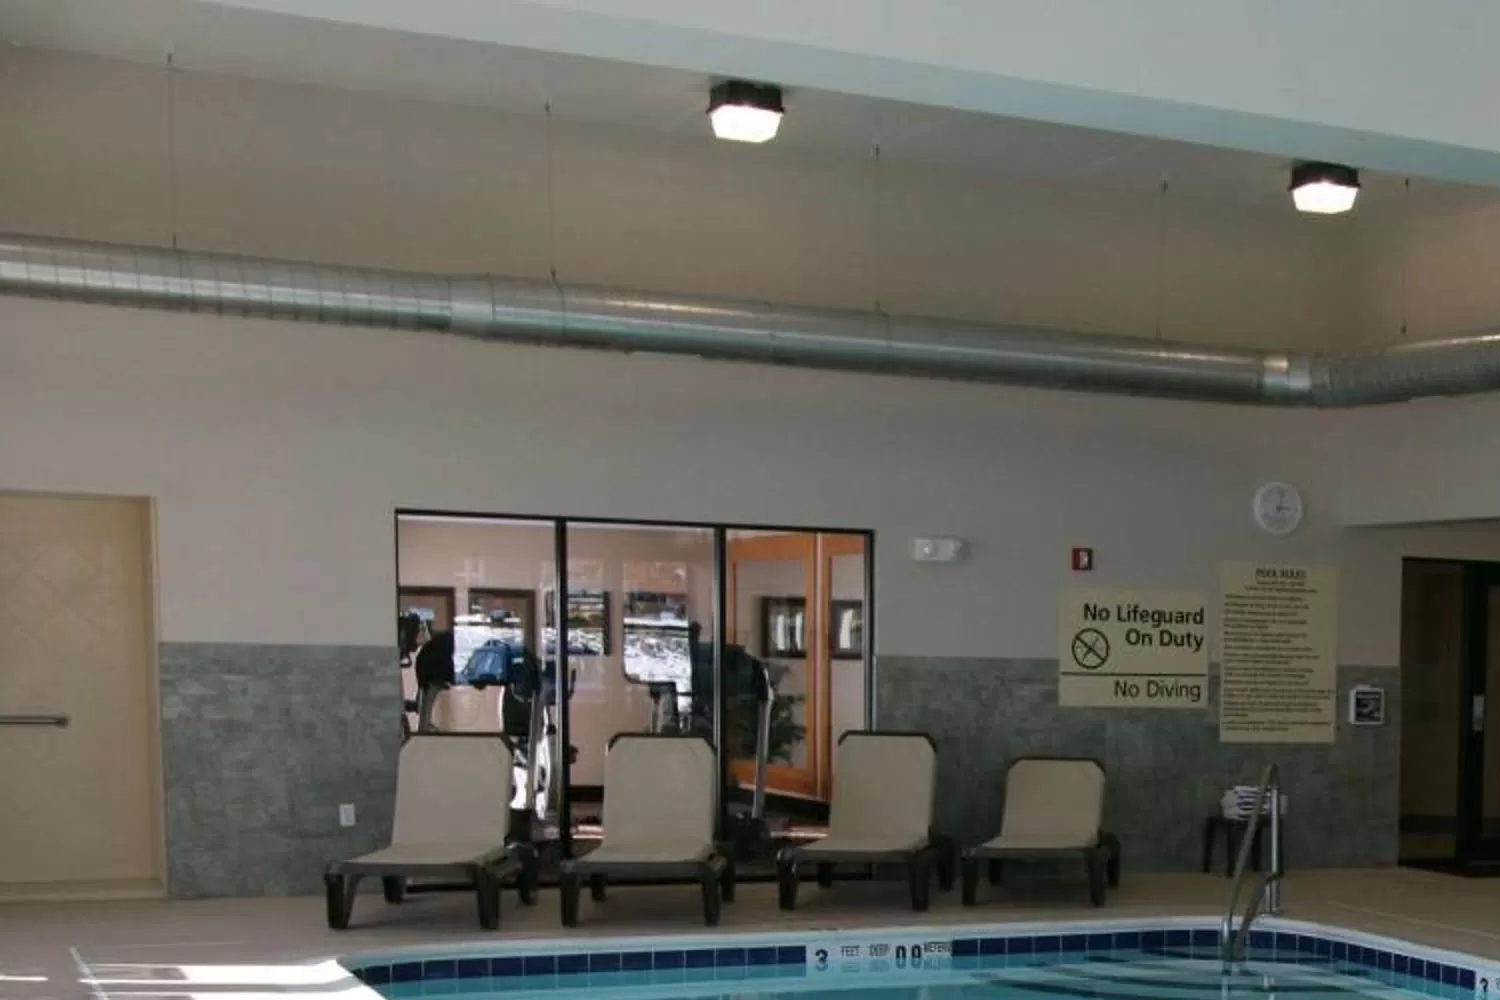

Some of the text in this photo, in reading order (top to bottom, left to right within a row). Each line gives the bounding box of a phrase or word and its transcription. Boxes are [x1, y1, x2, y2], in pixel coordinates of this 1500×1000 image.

[1084, 603, 1205, 628] No Lifeguard
[1125, 628, 1204, 653] On Duty
[1114, 680, 1201, 702] No Diving
